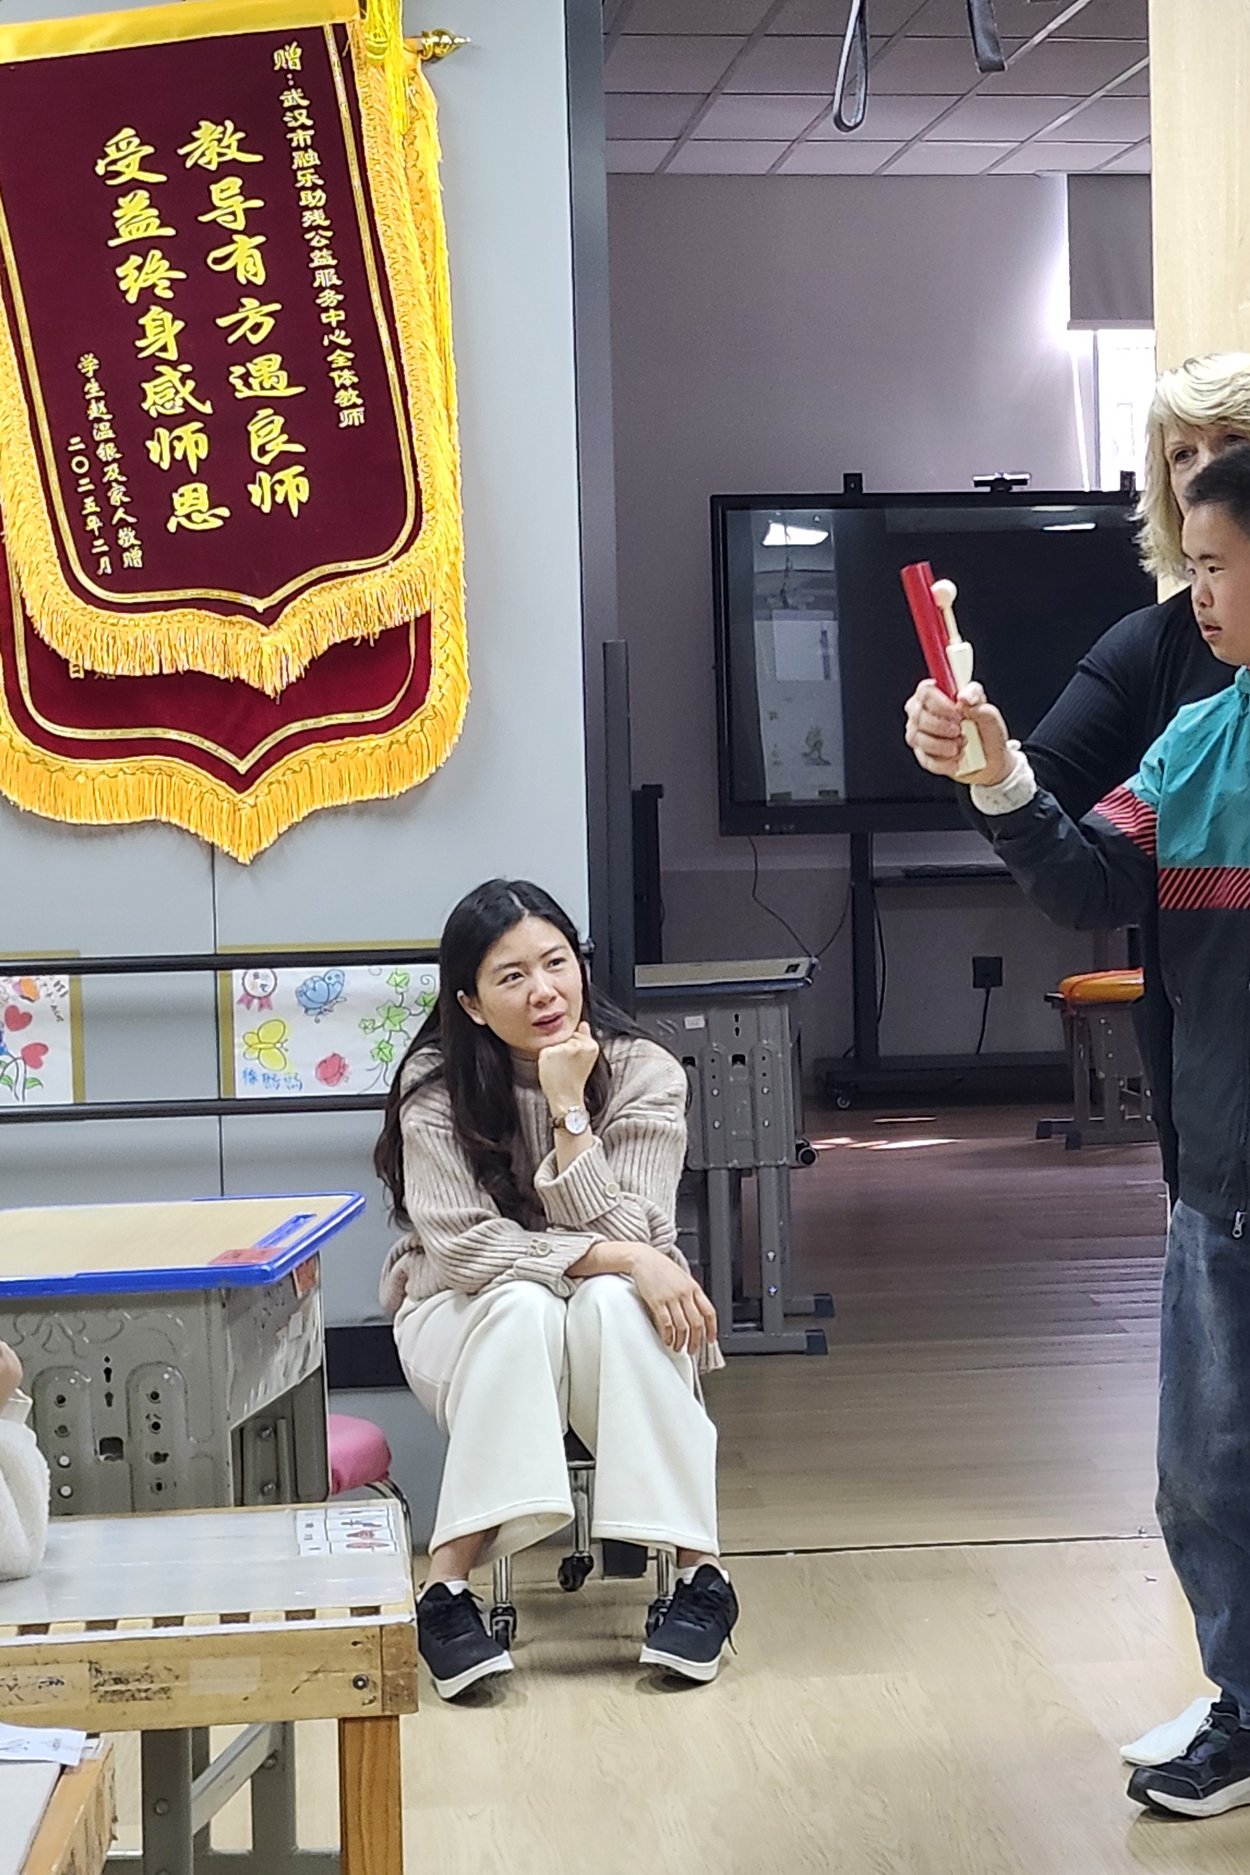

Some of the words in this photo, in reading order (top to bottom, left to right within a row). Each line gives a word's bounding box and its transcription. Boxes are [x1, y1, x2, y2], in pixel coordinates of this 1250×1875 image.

[95, 127, 231, 533] 受益终身感师恩
[178, 119, 310, 517] 教导有方遇良师
